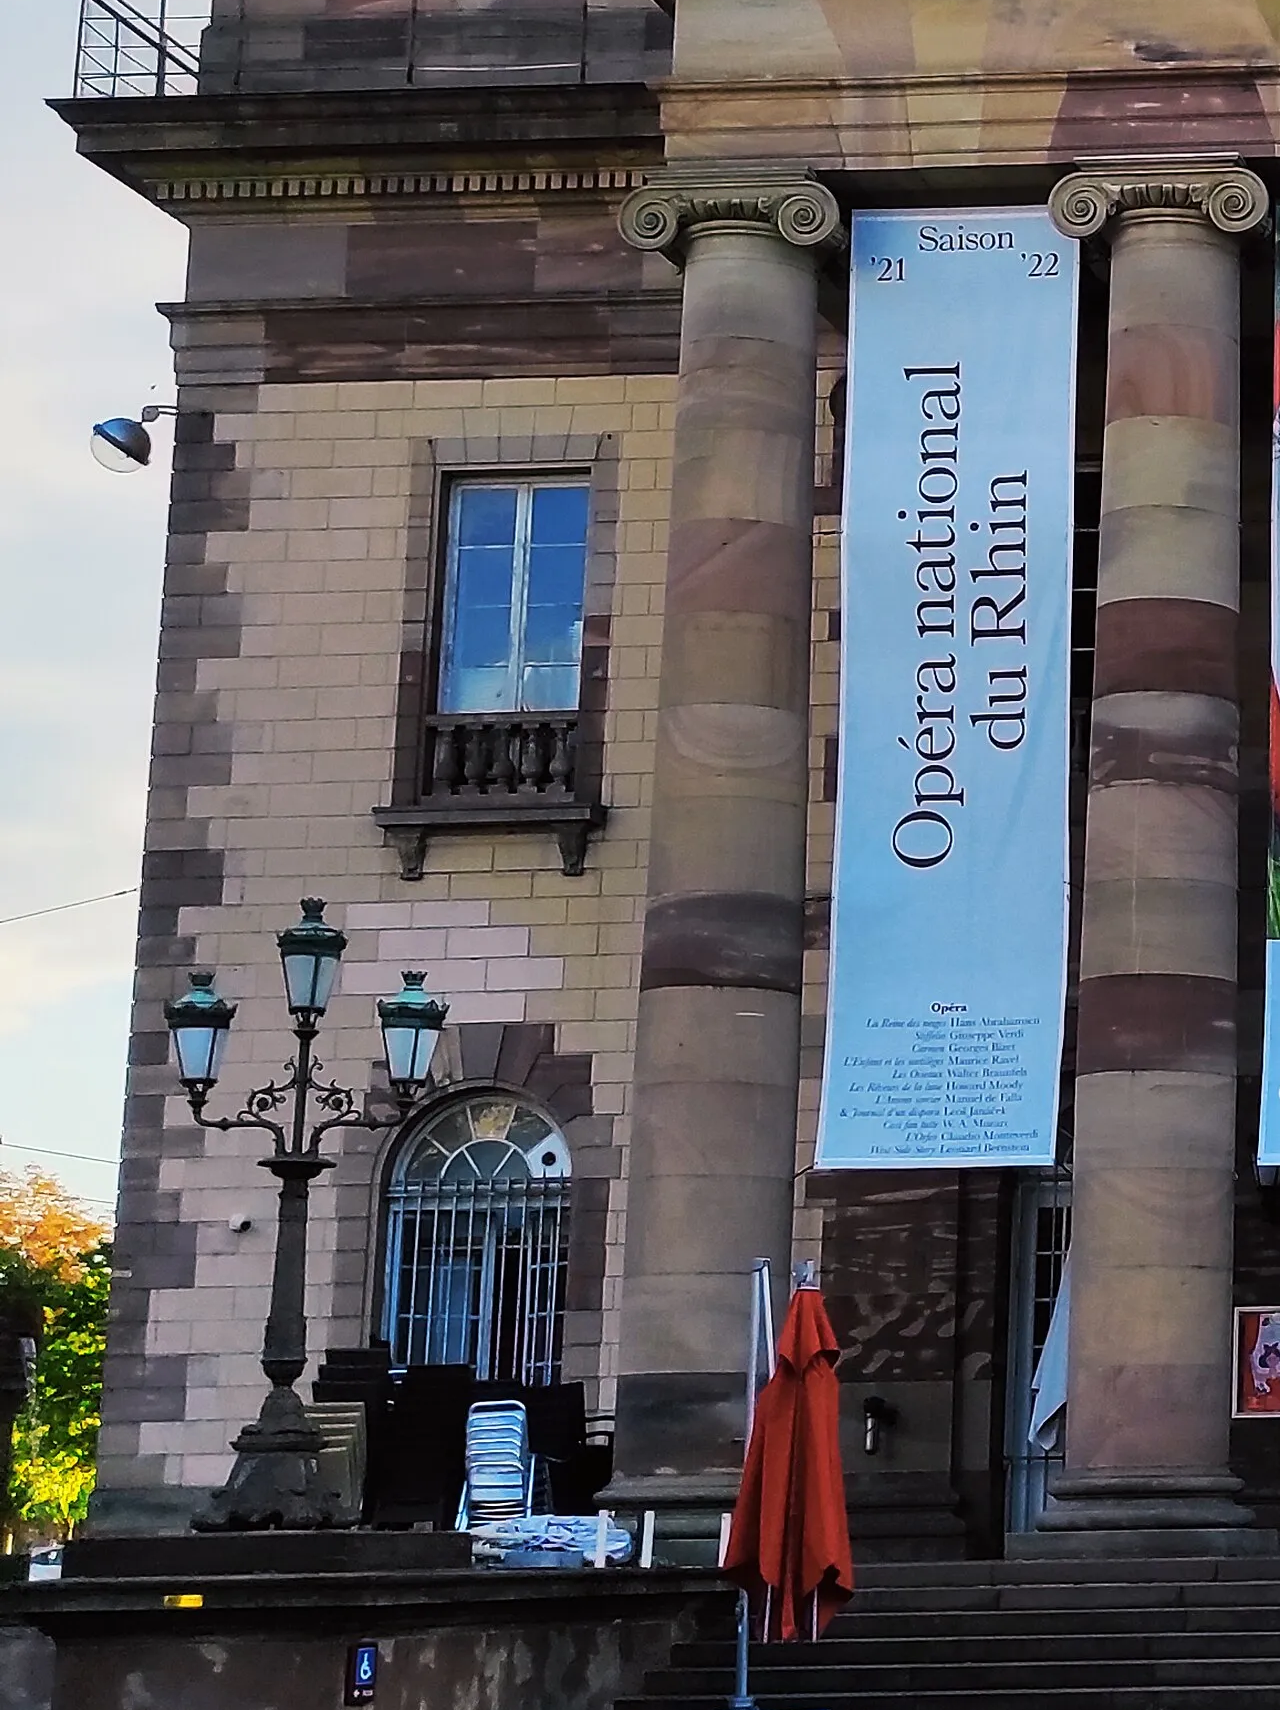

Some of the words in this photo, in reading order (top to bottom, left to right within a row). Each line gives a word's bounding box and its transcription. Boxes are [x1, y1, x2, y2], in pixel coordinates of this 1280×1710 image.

[870, 257, 906, 282] '21
[1021, 252, 1060, 278] '22
[918, 225, 1014, 252] Saison
[897, 361, 961, 638] national
[969, 469, 1027, 647] Rhin
[970, 665, 1027, 750] du
[892, 652, 964, 869] Opéra
[931, 1002, 967, 1015] Opéra
[989, 1080, 1023, 1091] Moody
